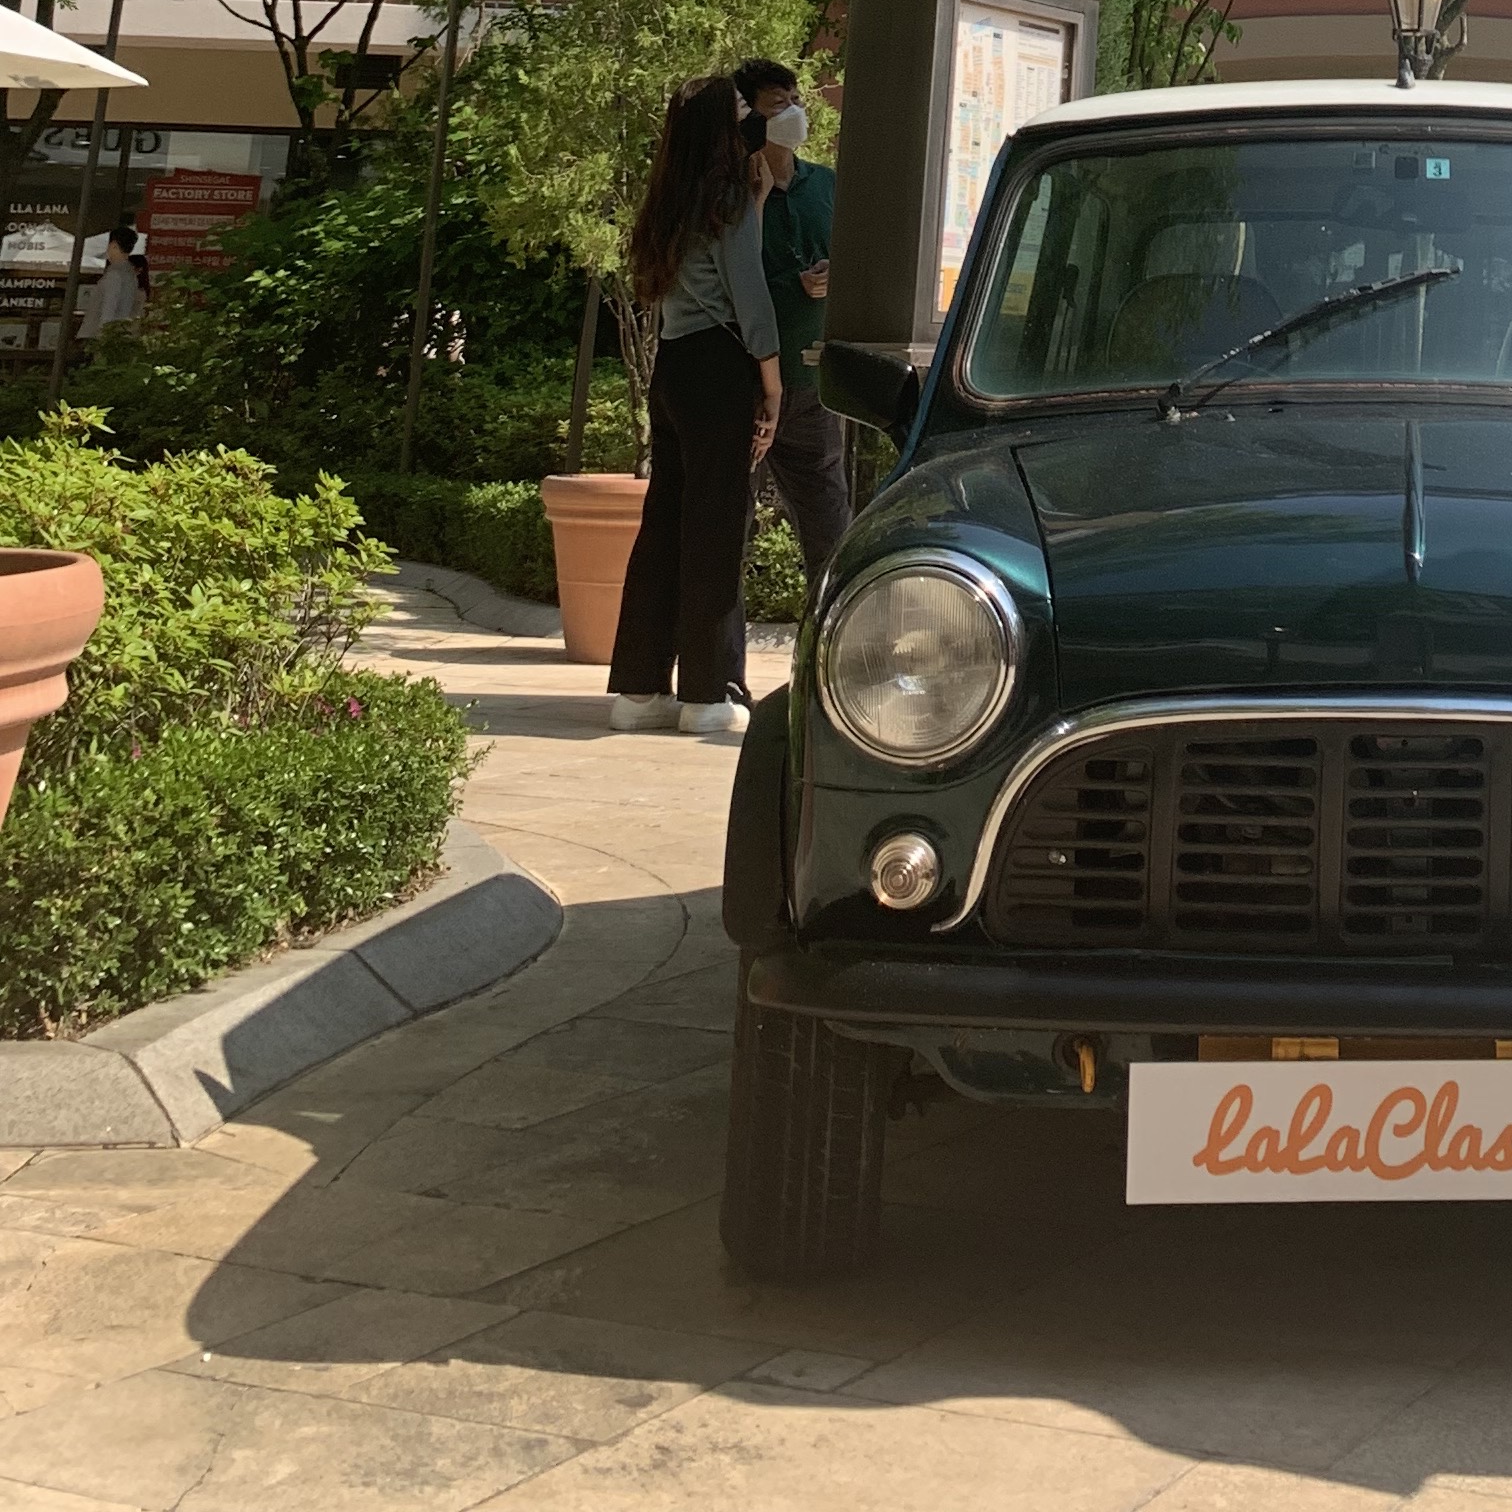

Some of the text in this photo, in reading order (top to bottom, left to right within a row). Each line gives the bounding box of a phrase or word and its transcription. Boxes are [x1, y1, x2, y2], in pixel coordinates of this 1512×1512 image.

[153, 188, 254, 201] FACTORY STORE
[0, 277, 56, 289] HAMPION
[0, 297, 45, 309] ANKEN
